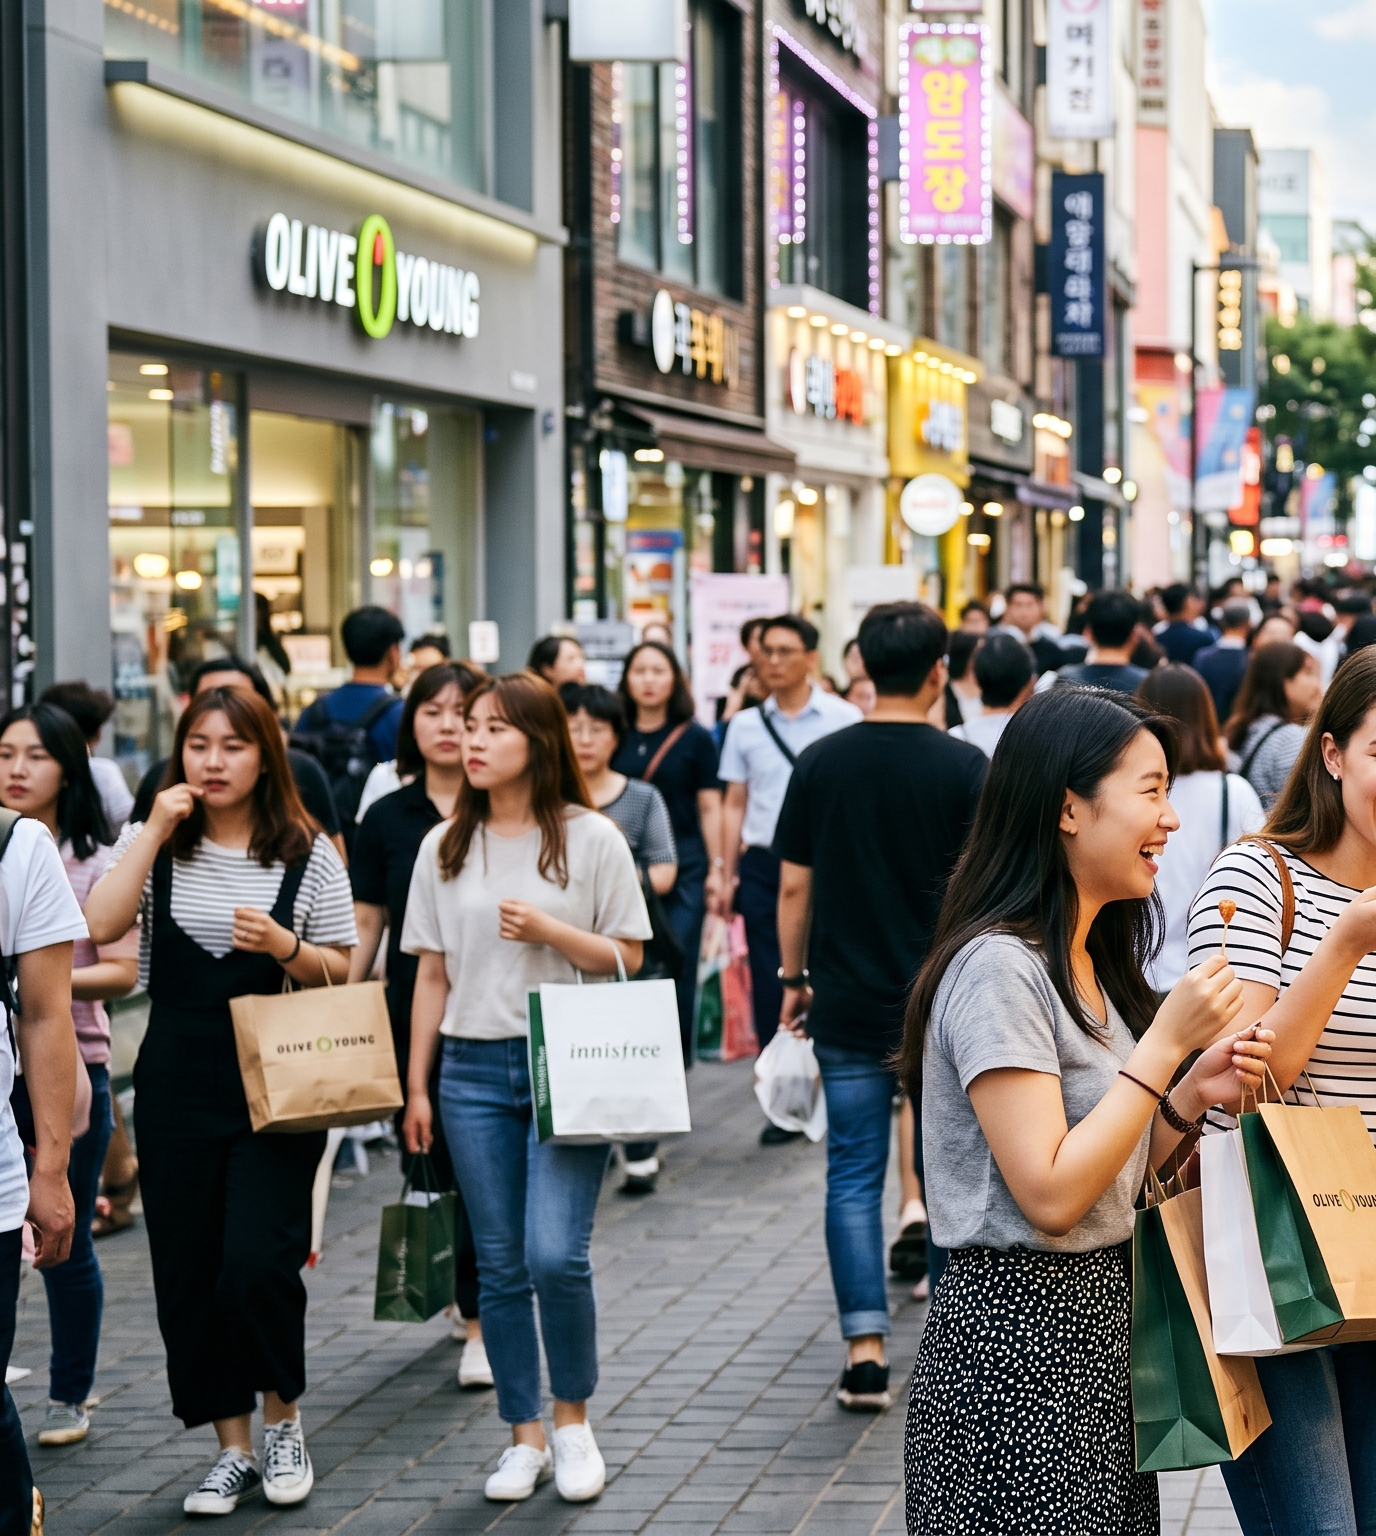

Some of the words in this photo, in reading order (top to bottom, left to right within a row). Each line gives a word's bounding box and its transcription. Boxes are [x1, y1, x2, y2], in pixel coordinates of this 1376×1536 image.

[921, 70, 970, 213] 암도장
[265, 212, 357, 308] OLIVE
[395, 250, 481, 339] YOUNG
[277, 1042, 313, 1054] OLIVE
[334, 1034, 376, 1047] YOUNG
[570, 1040, 661, 1061] innisfree
[1312, 1193, 1343, 1207] OLIVE
